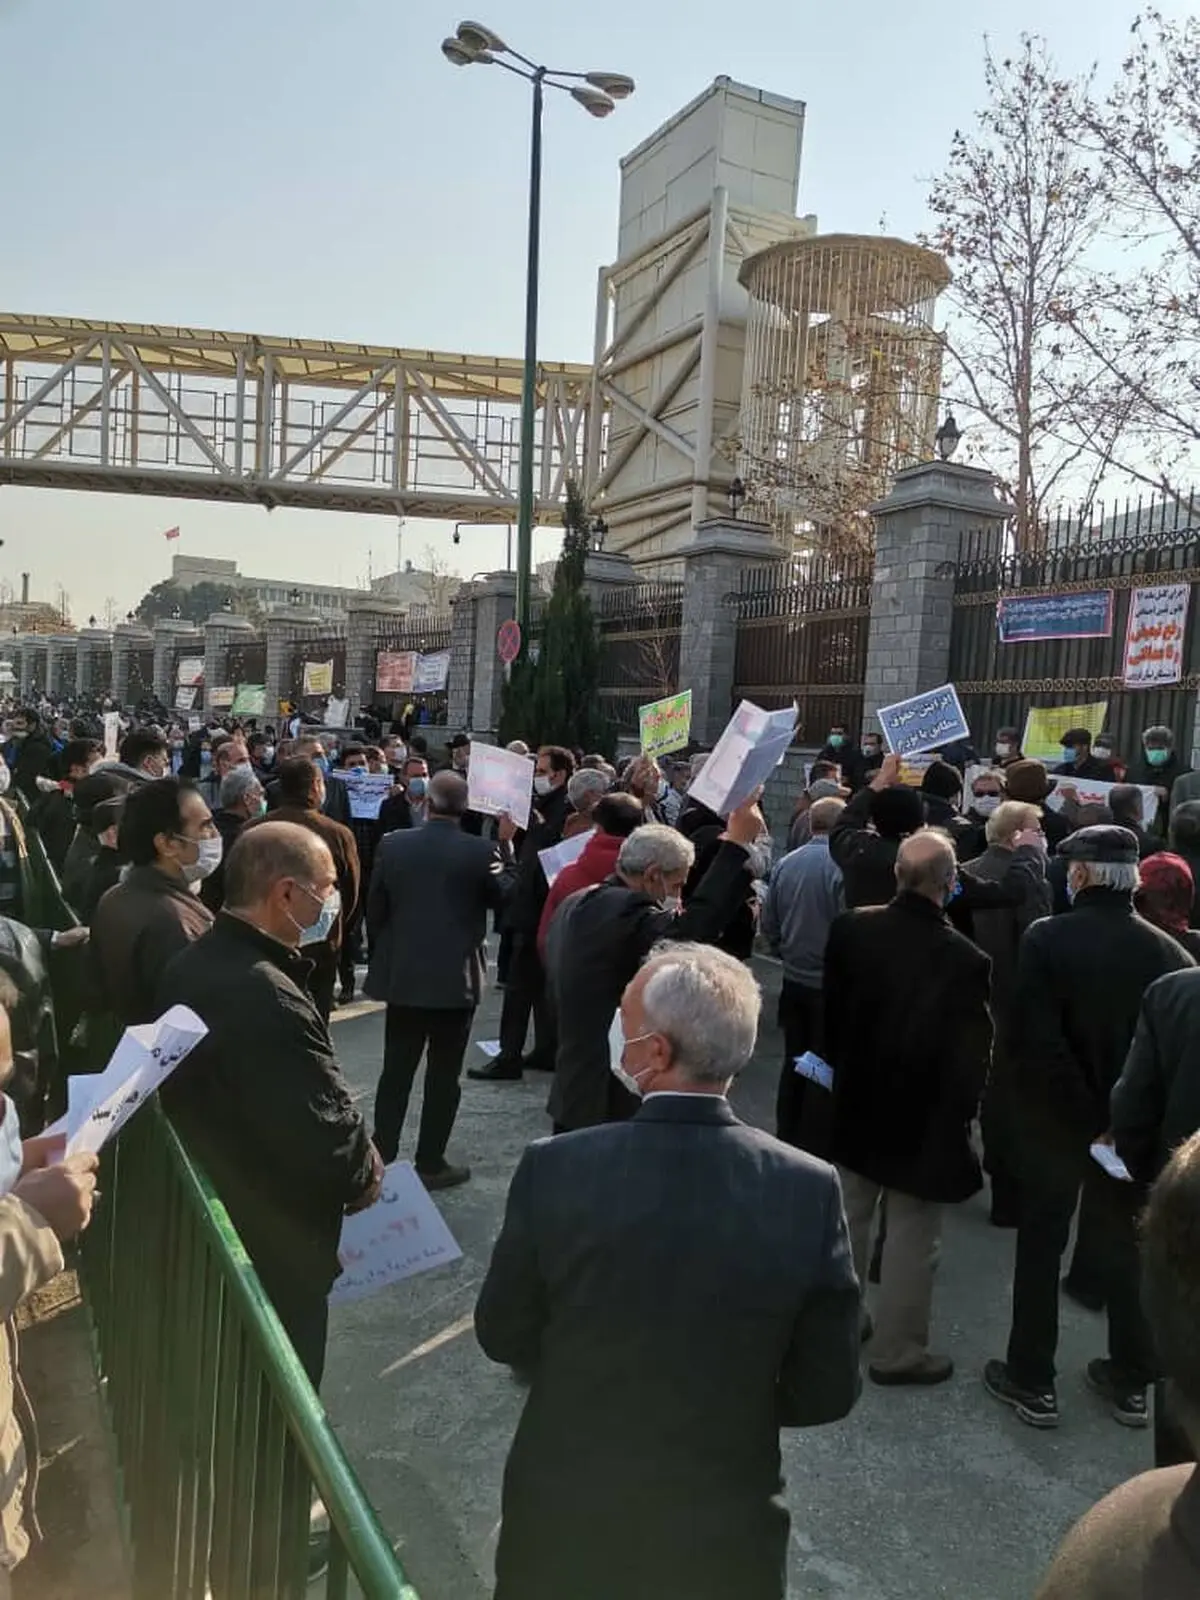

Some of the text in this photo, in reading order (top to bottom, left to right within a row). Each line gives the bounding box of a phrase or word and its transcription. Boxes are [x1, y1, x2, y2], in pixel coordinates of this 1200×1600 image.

[890, 693, 952, 728] افزایش حقوق
[918, 729, 928, 739] با
[929, 719, 958, 738] مطابق
